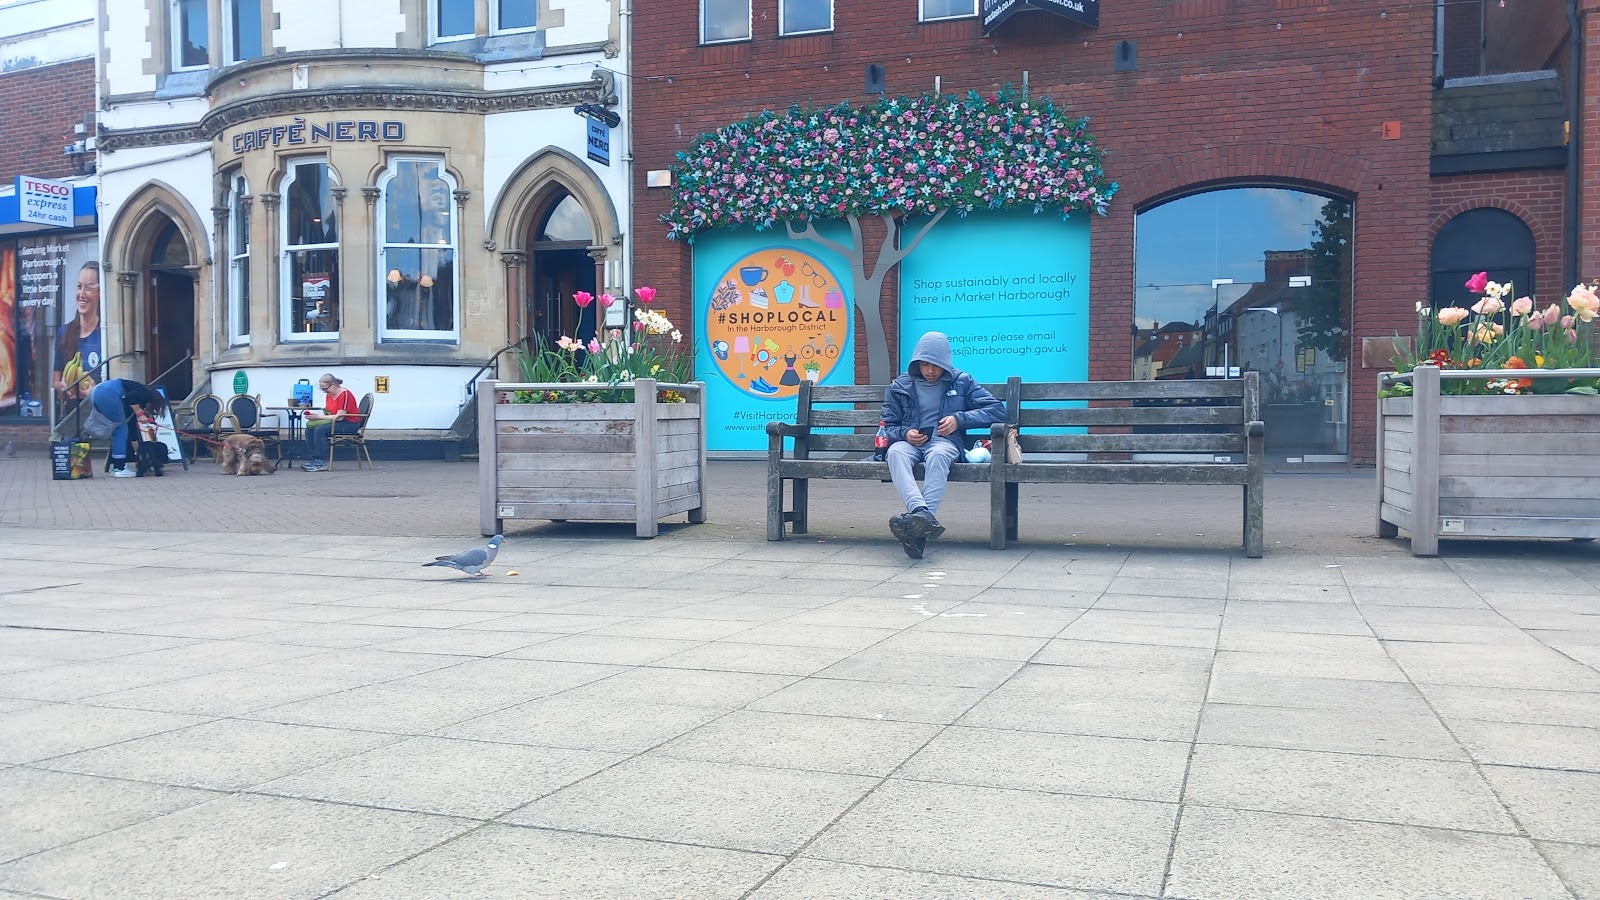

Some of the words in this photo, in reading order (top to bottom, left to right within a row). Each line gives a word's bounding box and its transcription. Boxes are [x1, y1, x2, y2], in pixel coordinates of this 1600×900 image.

[232, 117, 305, 154] CAFFÈ
[311, 120, 405, 143] NERO
[588, 135, 609, 152] NERO
[25, 181, 69, 196] TESCO
[27, 198, 67, 211] express
[28, 209, 46, 219] 24hr
[48, 214, 67, 222] cash
[22, 246, 46, 256] Serving
[46, 244, 70, 255] Market
[22, 257, 67, 269] Harborough's
[22, 273, 52, 283] shoppers
[913, 280, 942, 290] Shop
[945, 275, 1009, 288] sustainably
[1012, 274, 1036, 285] and
[1038, 272, 1077, 285] locally
[22, 286, 37, 294] little
[38, 284, 60, 293] better
[913, 294, 939, 304] here
[941, 293, 952, 303] in
[954, 291, 995, 303] Market
[998, 288, 1070, 301] Harborough
[22, 299, 41, 308] every
[718, 310, 837, 324] #SHOPLOCAL
[750, 323, 797, 333] Harborough
[799, 323, 827, 331] District
[947, 335, 989, 344] enquires
[991, 331, 1024, 342] please
[1027, 331, 1056, 341] email
[950, 344, 1068, 357] ss@harborough.gov.uk
